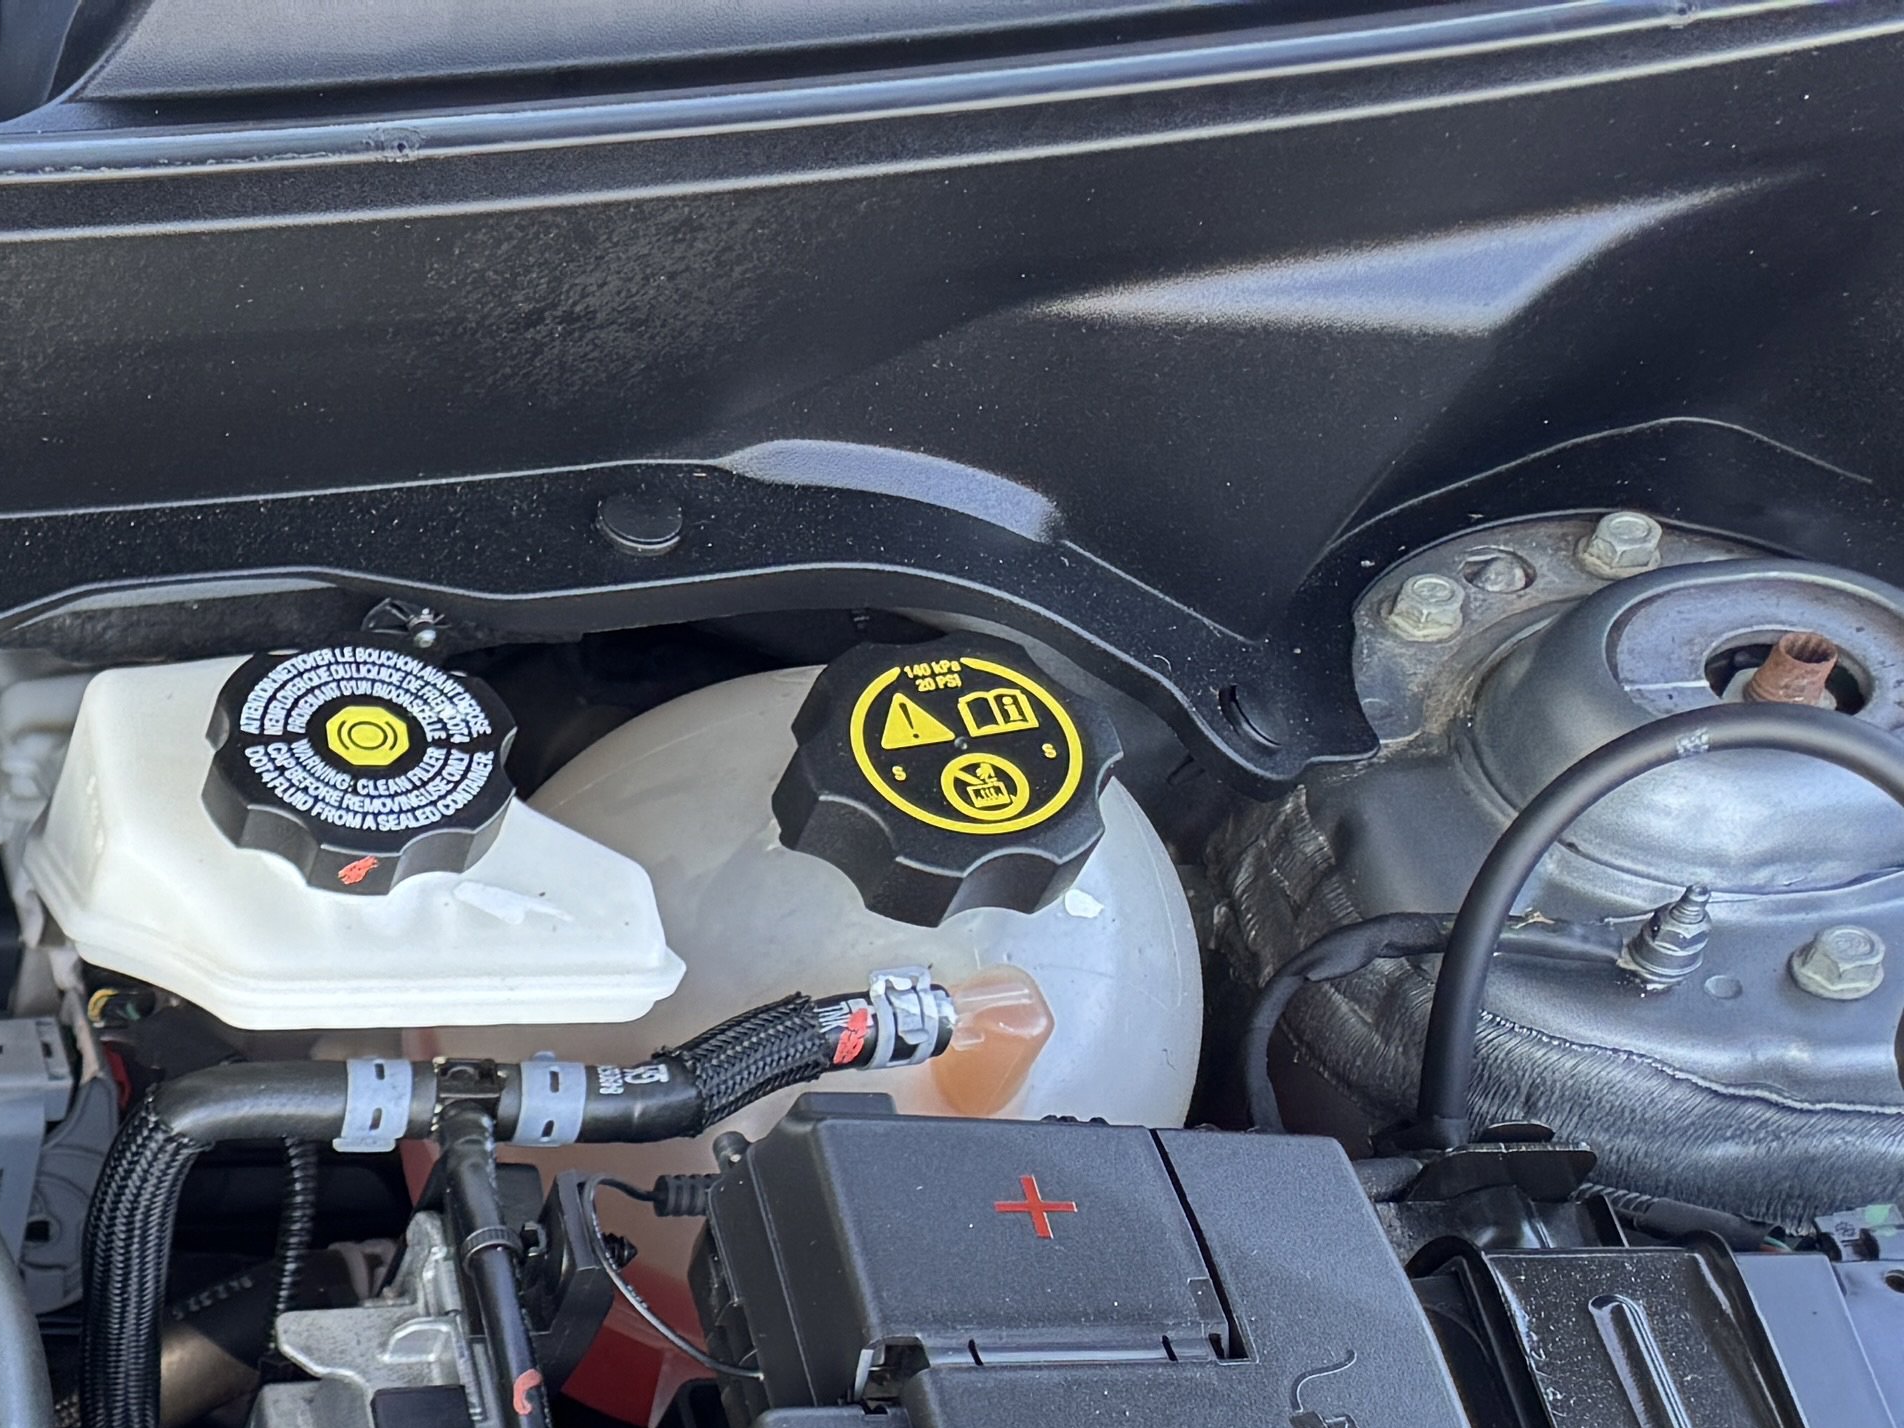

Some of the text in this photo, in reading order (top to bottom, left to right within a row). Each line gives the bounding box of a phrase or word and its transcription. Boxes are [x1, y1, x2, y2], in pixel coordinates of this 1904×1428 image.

[330, 664, 352, 679] DU
[351, 663, 409, 685] LIQUIDE
[402, 675, 425, 693] DE
[334, 646, 355, 662] LE
[356, 647, 423, 674] BOUCHON
[417, 666, 464, 697] AVANT
[903, 659, 961, 679] 140 kPa
[915, 674, 962, 692] 20 PSI
[372, 682, 419, 707] BIDON
[267, 742, 296, 772] CAP
[284, 765, 343, 806] BEFORE
[442, 749, 469, 781] ONLY
[291, 739, 446, 798] WARNING: CLEAN FILLER
[267, 776, 314, 811] FLUID
[311, 802, 363, 828] FROM
[363, 814, 376, 830] A
[377, 800, 441, 831] SEALED
